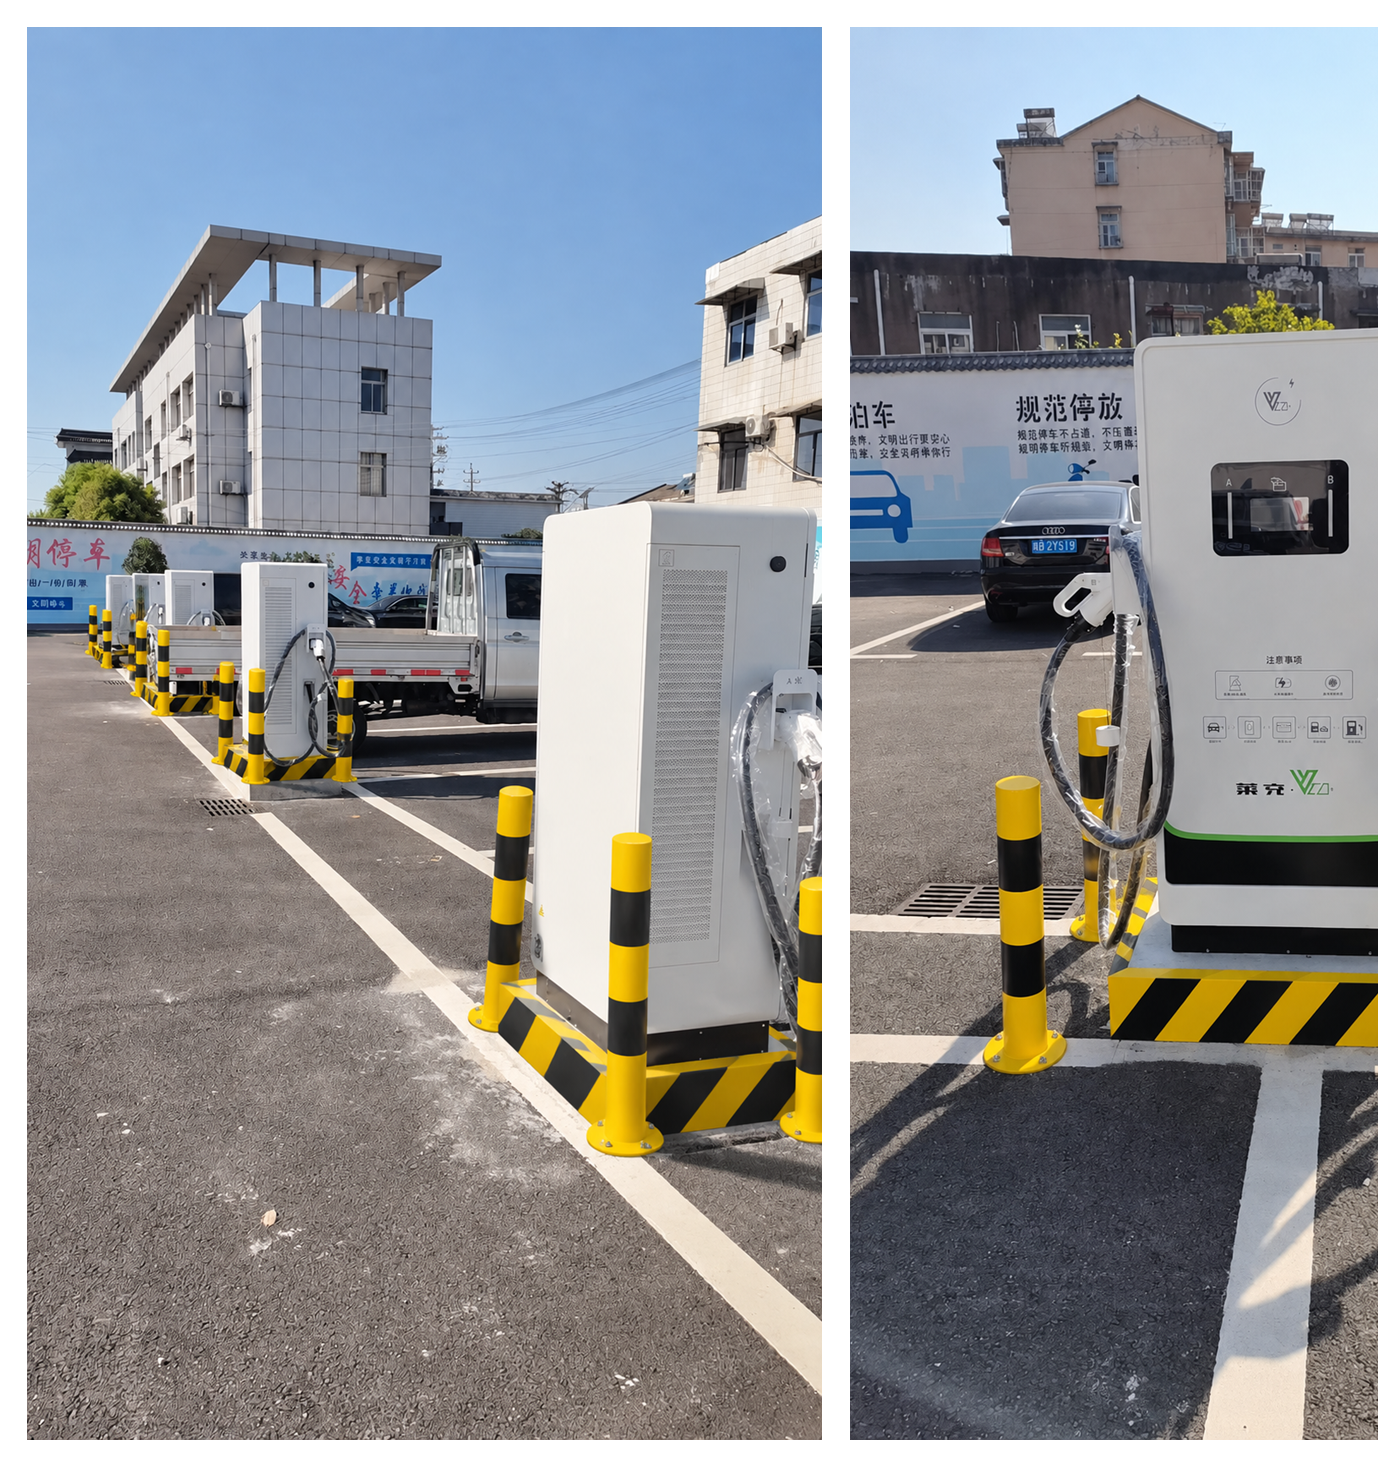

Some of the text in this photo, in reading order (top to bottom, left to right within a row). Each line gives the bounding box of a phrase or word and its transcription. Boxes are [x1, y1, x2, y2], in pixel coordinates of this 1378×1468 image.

[1015, 392, 1123, 423] 规范停放
[1225, 475, 1334, 487] A B
[1266, 655, 1303, 665] 注意事项
